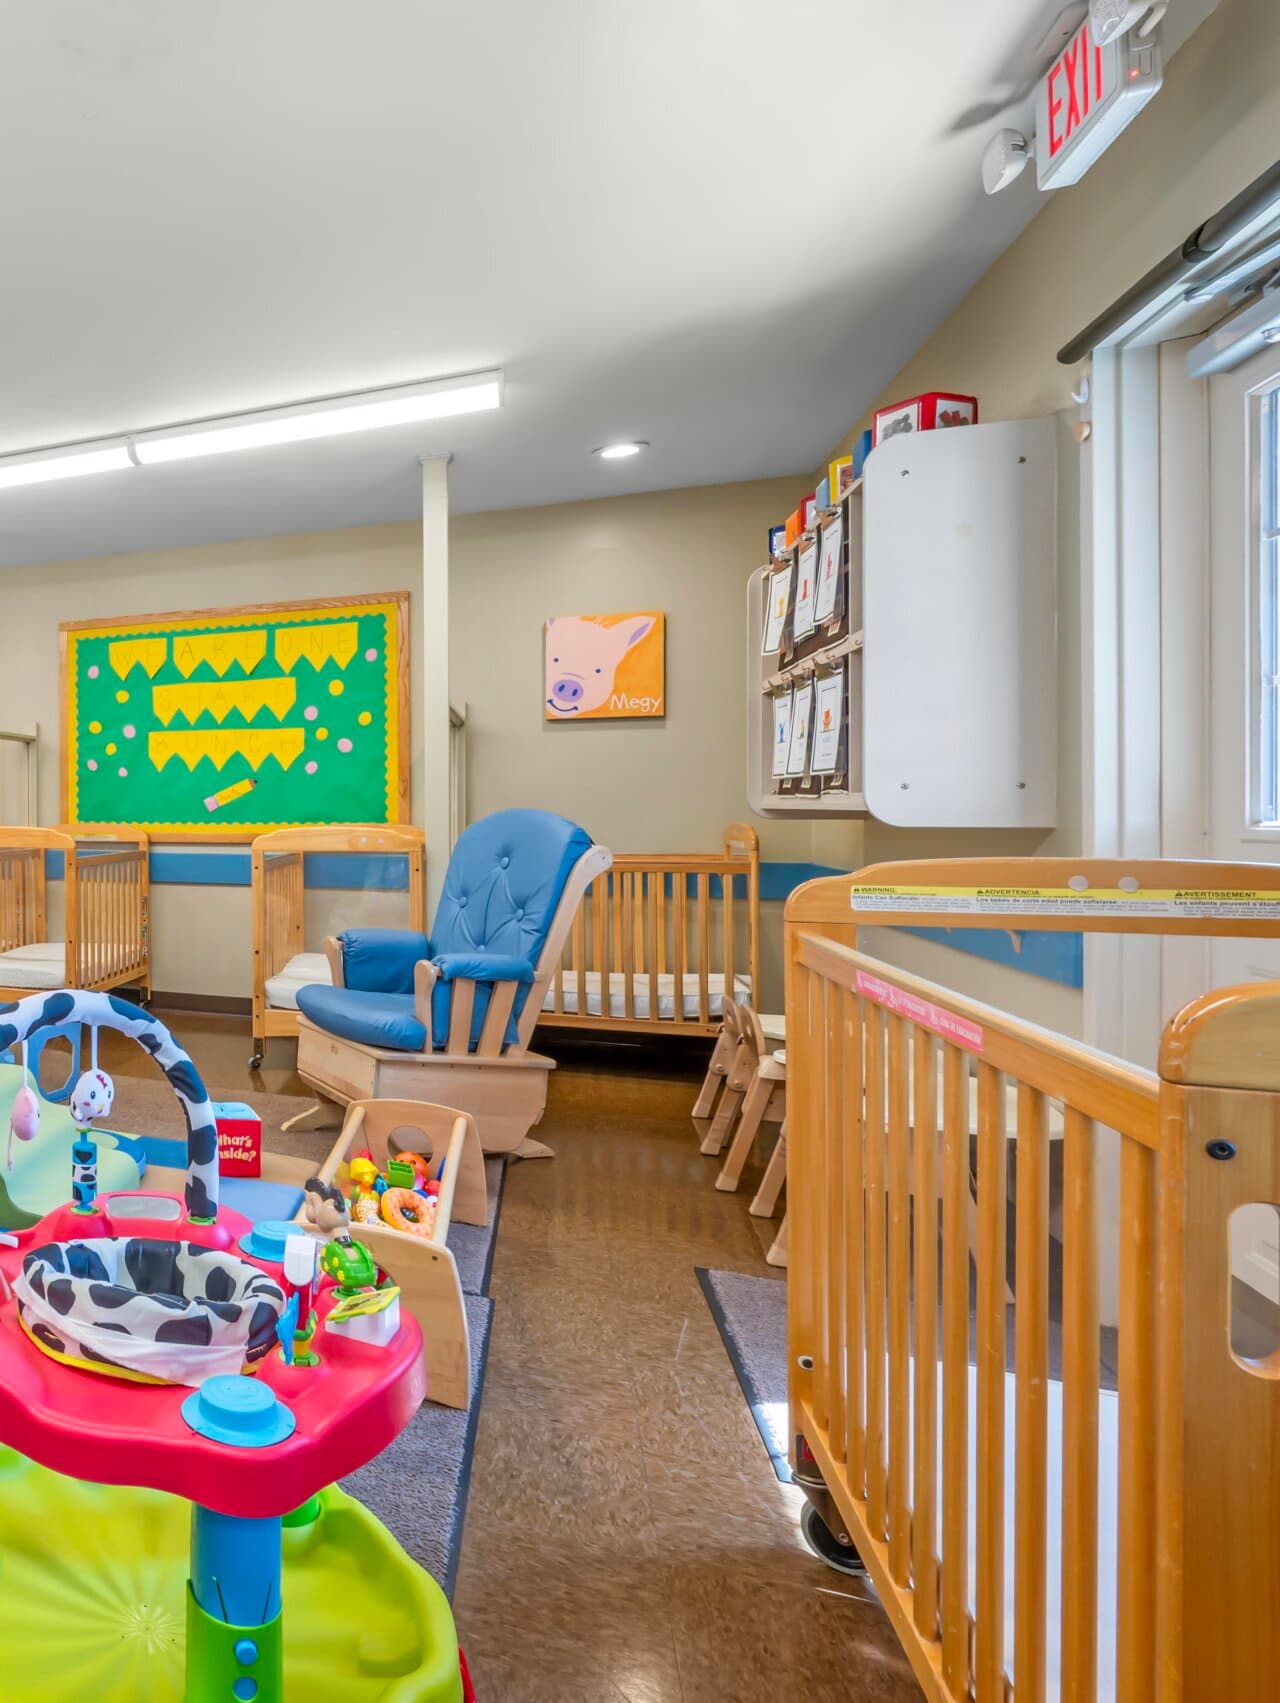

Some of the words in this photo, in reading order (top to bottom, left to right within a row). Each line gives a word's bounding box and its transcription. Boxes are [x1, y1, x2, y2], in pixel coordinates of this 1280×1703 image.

[180, 636, 260, 661] ARE
[280, 628, 352, 655] ONE
[610, 693, 661, 712] Megy
[219, 1147, 256, 1162] side?
